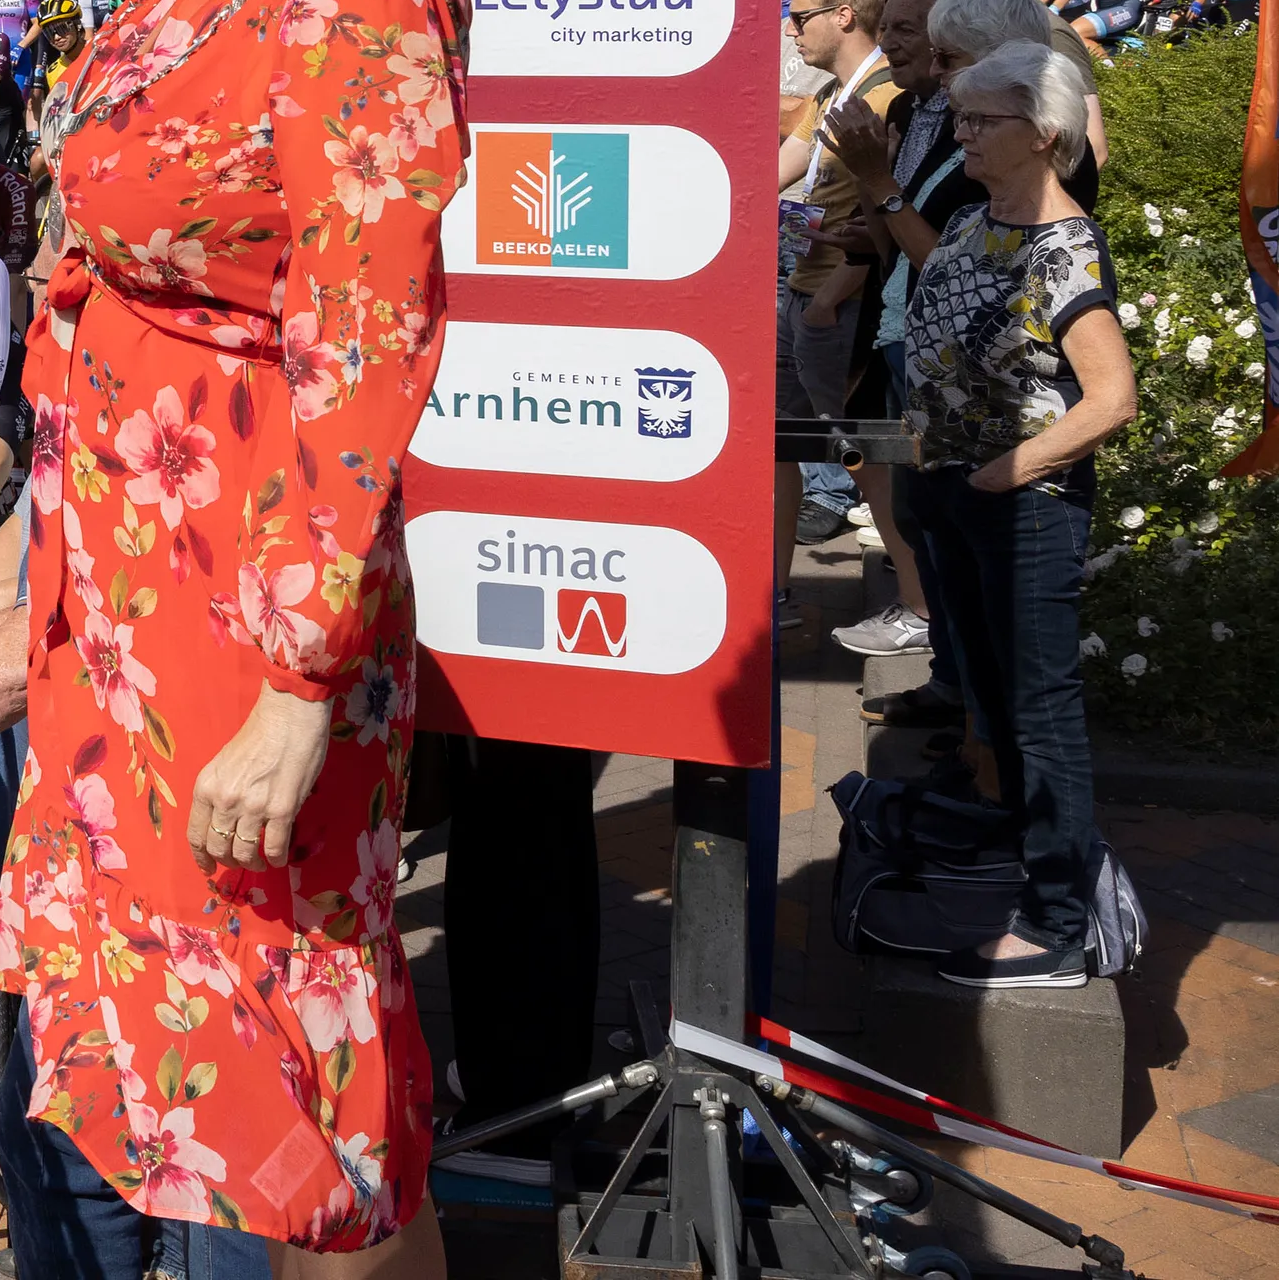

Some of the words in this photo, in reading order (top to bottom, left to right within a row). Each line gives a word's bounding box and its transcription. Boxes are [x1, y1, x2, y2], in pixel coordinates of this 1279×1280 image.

[550, 27, 586, 46] city
[593, 27, 693, 46] marketing
[1, 171, 28, 226] Roland
[493, 242, 610, 257] BEEKDAELEN
[513, 371, 623, 386] GEMEENTE
[424, 387, 622, 427] Arnhem
[477, 530, 627, 583] simac
